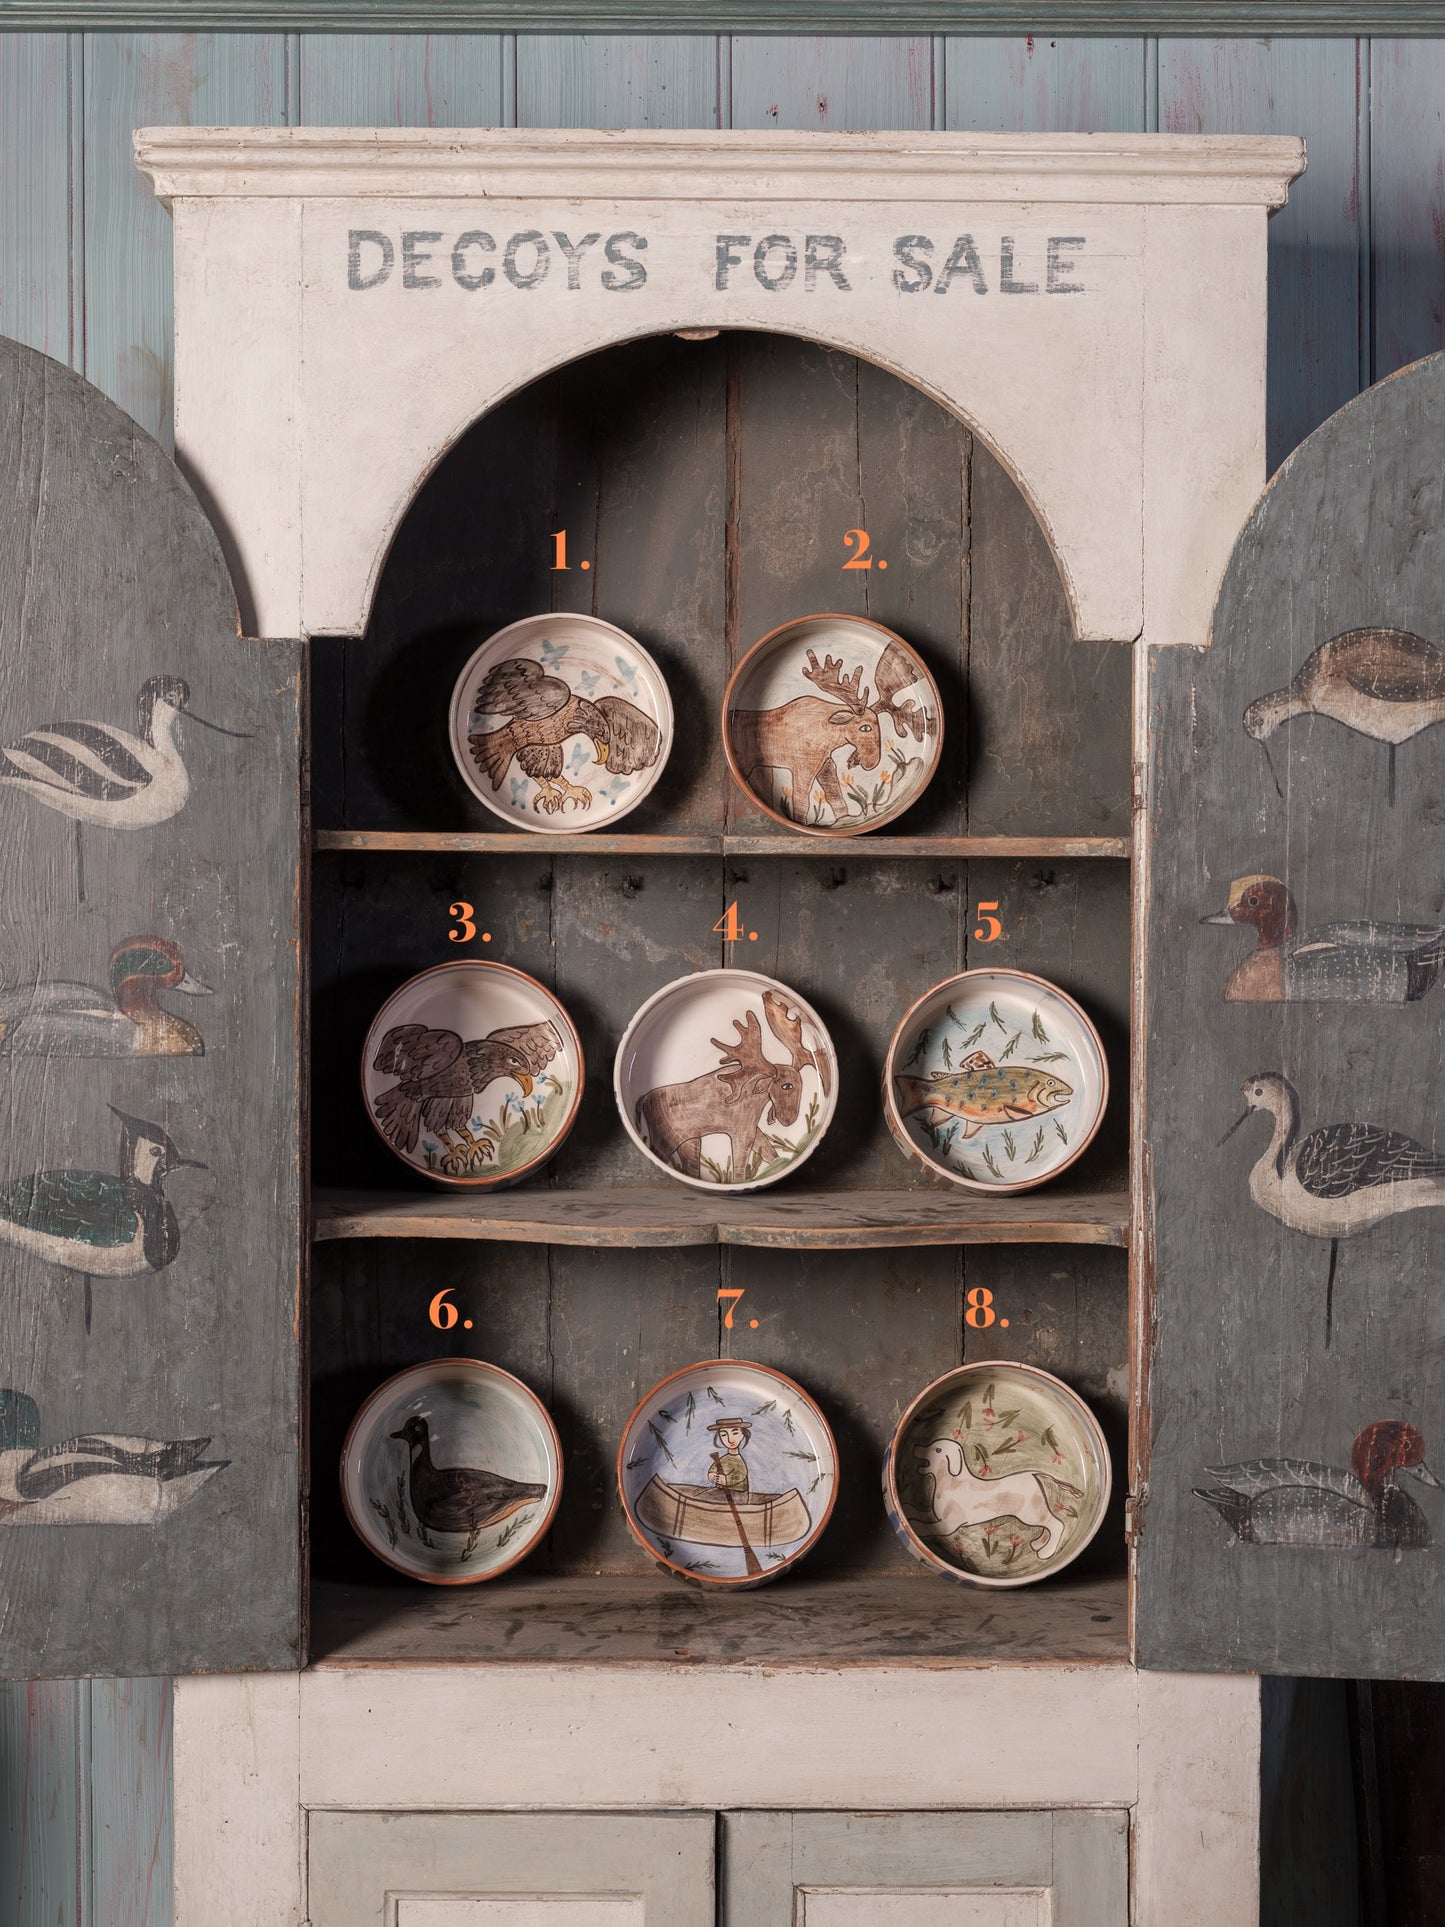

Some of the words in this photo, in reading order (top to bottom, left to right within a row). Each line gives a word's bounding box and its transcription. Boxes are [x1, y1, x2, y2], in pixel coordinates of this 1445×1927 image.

[348, 229, 648, 292] DECOYS
[715, 234, 852, 292] FOR
[891, 233, 1087, 294] SALE
